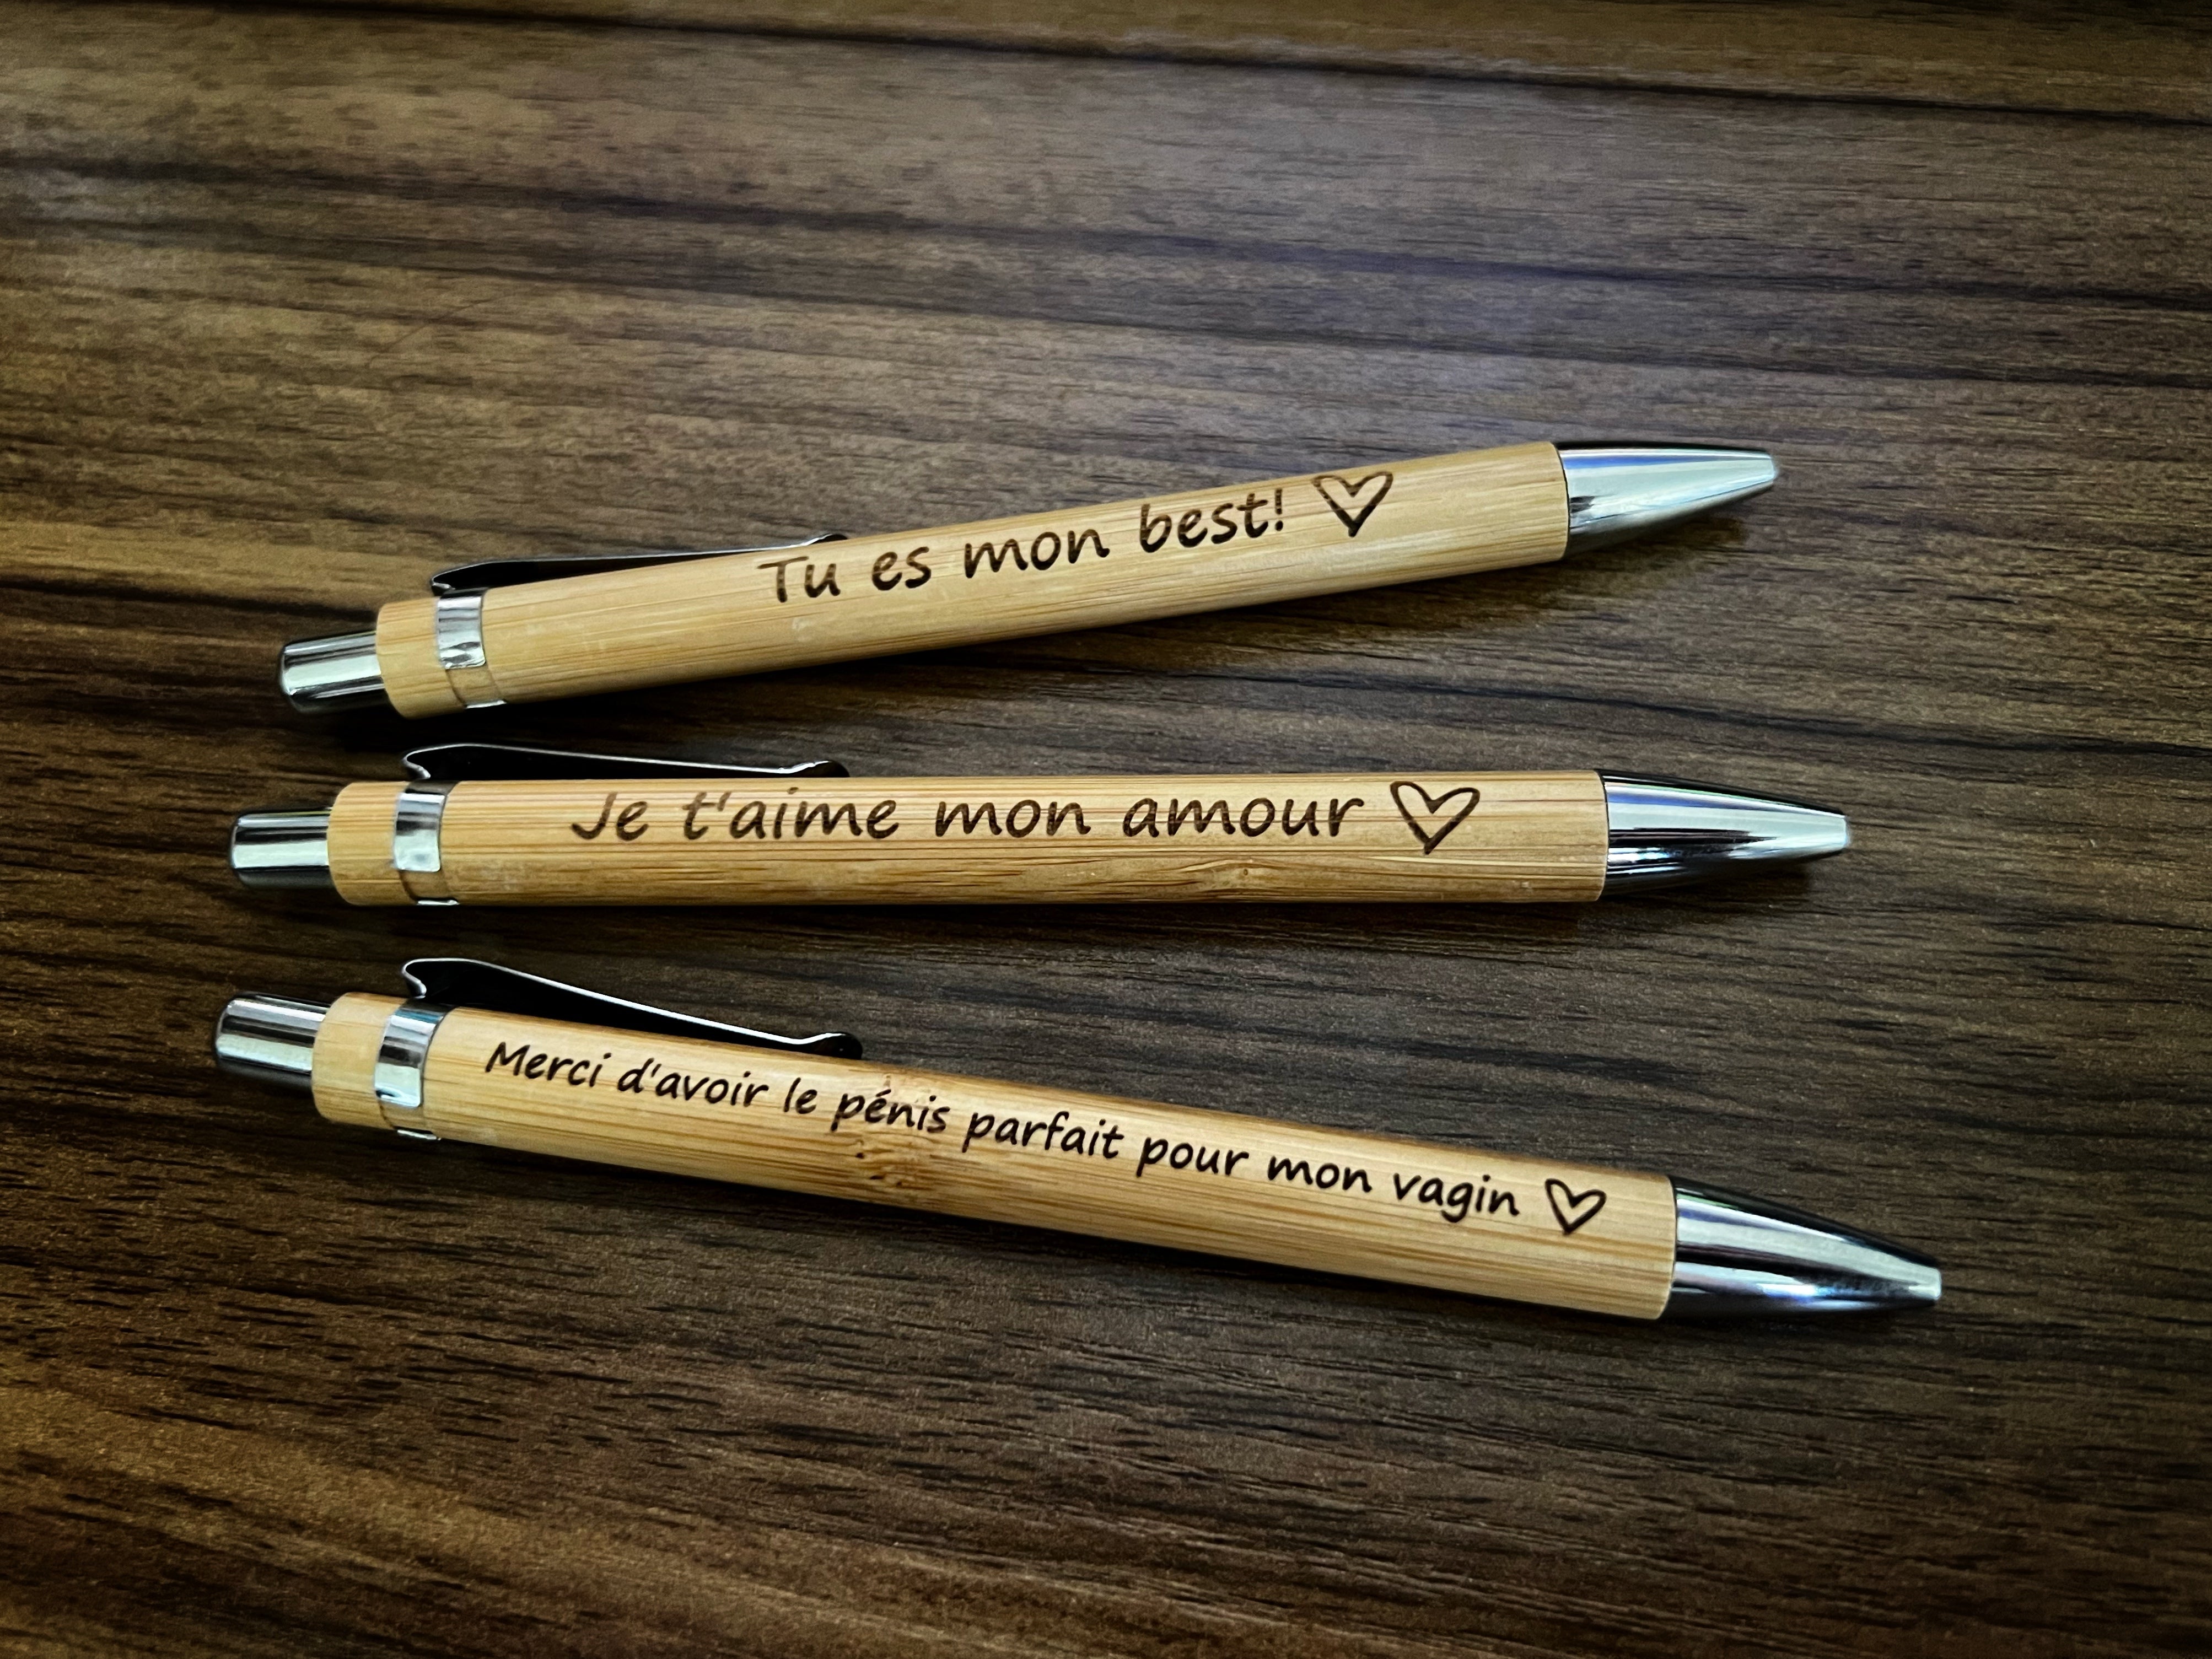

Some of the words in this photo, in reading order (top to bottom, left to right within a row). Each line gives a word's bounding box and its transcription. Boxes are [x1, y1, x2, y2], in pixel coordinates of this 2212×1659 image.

[757, 554, 841, 604] Tu
[871, 545, 932, 592] es
[964, 529, 1110, 579] mon
[1139, 487, 1284, 553] best!
[569, 791, 649, 842] Je
[682, 787, 900, 841] t'aime
[935, 799, 1092, 839] mon
[1122, 797, 1365, 838] amour
[485, 1041, 612, 1088] Merci
[616, 1057, 770, 1108] d'avoir
[783, 1077, 818, 1116] le
[830, 1088, 951, 1133] pénis
[961, 1110, 1126, 1160] parfait
[1135, 1136, 1250, 1179] pour
[1267, 1155, 1374, 1193] mon
[1393, 1173, 1521, 1224] vagin
